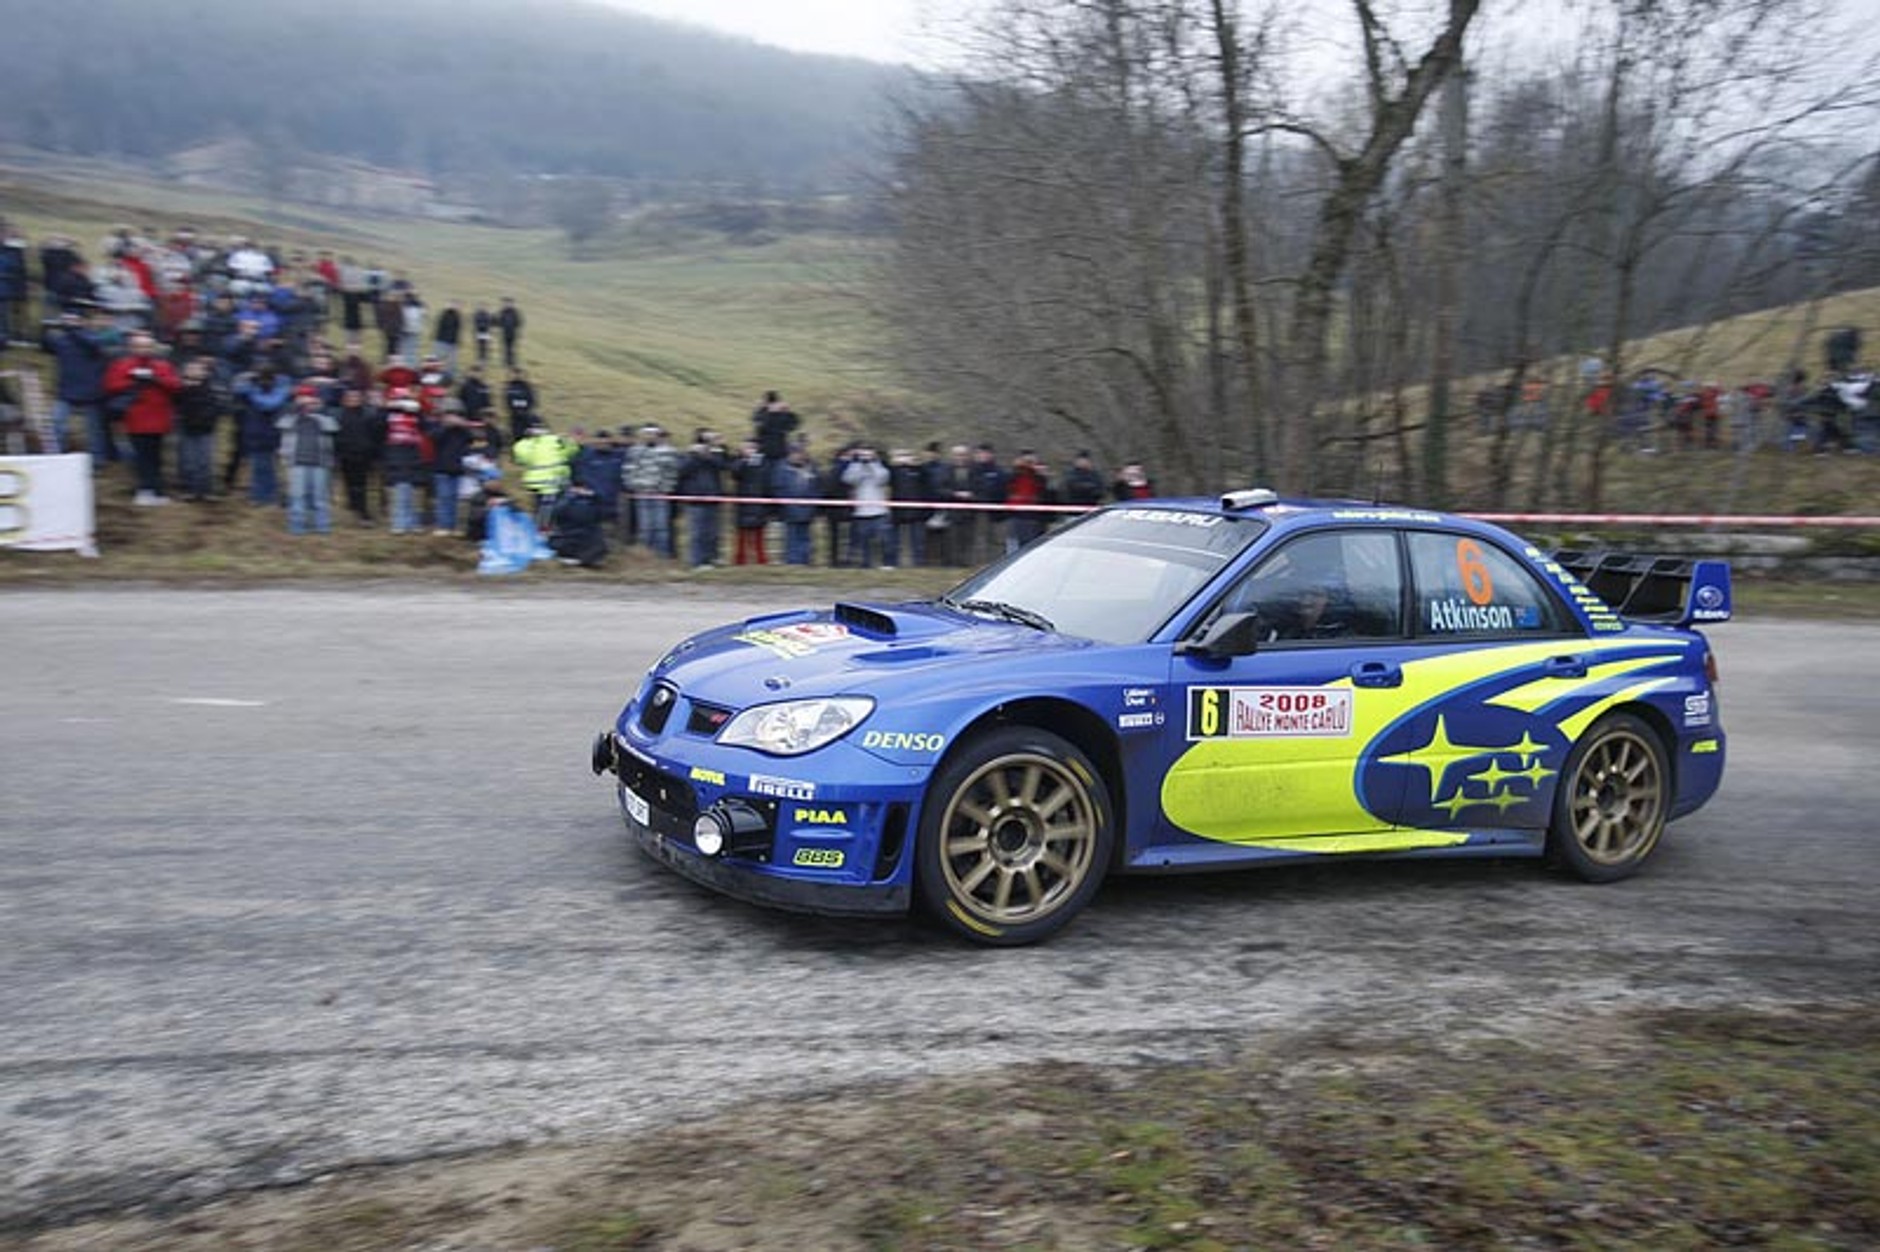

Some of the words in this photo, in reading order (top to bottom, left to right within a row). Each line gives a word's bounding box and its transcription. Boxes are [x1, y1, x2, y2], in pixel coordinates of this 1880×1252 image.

[1456, 537, 1494, 606] 6
[1430, 598, 1513, 631] Atkinson
[1201, 688, 1220, 737] 6
[1236, 699, 1272, 732] RALLYE
[1273, 713, 1309, 731] MONTE
[1311, 699, 1346, 731] CARLO
[1258, 694, 1327, 713] 2008
[862, 730, 946, 752] DENSO
[795, 808, 847, 824] PIAA
